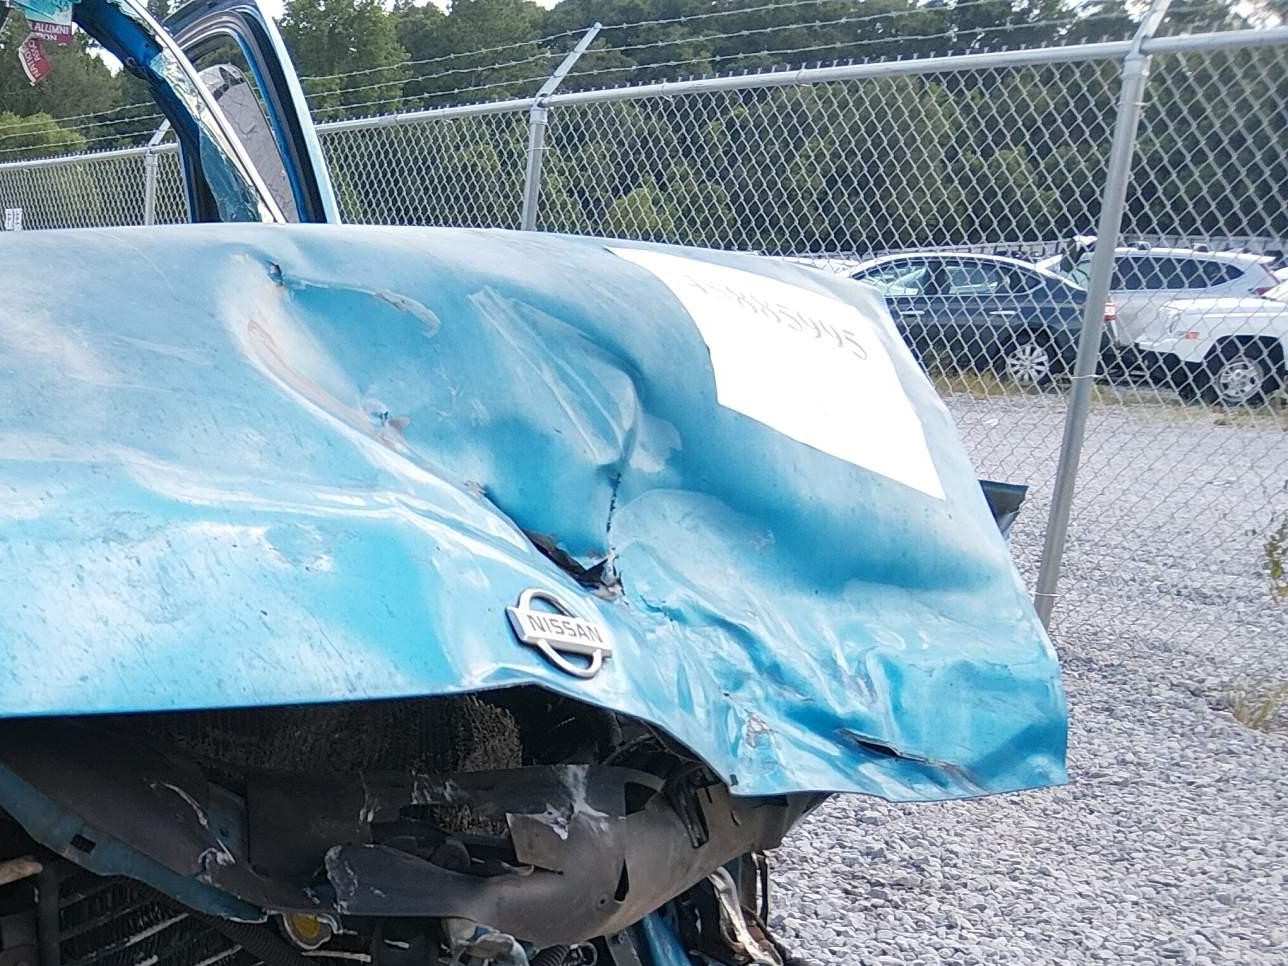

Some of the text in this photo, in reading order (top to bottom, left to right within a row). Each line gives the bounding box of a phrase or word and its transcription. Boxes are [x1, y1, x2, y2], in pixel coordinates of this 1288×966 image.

[33, 22, 70, 35] ALUMNI
[684, 275, 868, 361] 885995
[526, 613, 605, 644] NISSAN
